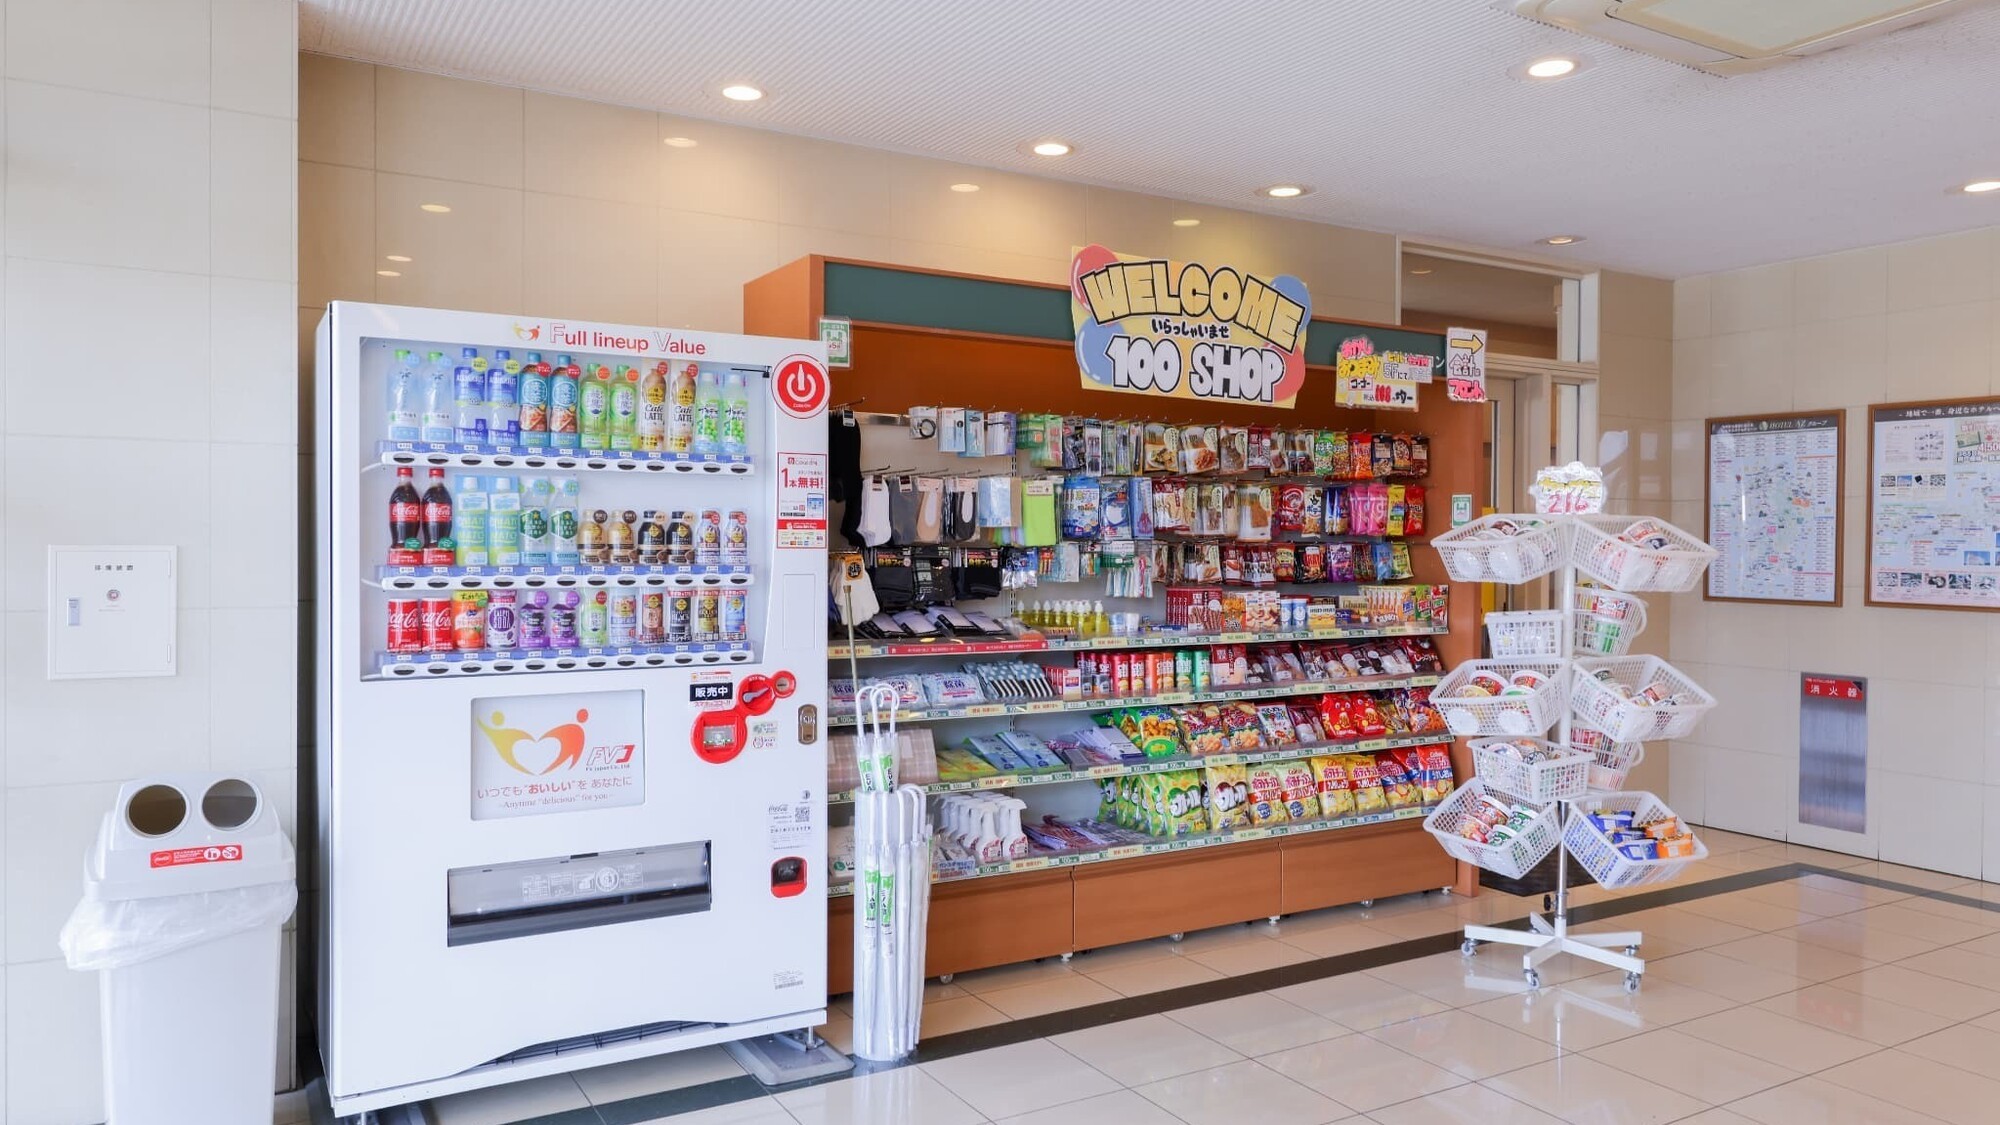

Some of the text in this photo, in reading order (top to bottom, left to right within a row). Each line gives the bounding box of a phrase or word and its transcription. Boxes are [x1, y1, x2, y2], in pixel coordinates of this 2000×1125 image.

[1080, 260, 1306, 354] WELCOME
[549, 323, 706, 355] Full lineup Value
[1151, 318, 1230, 339] いらっしゃいませ
[1104, 335, 1285, 402] 100 SHOP
[695, 686, 729, 698] 販売中
[1810, 684, 1858, 698] 消火器
[591, 776, 633, 788] あなたに
